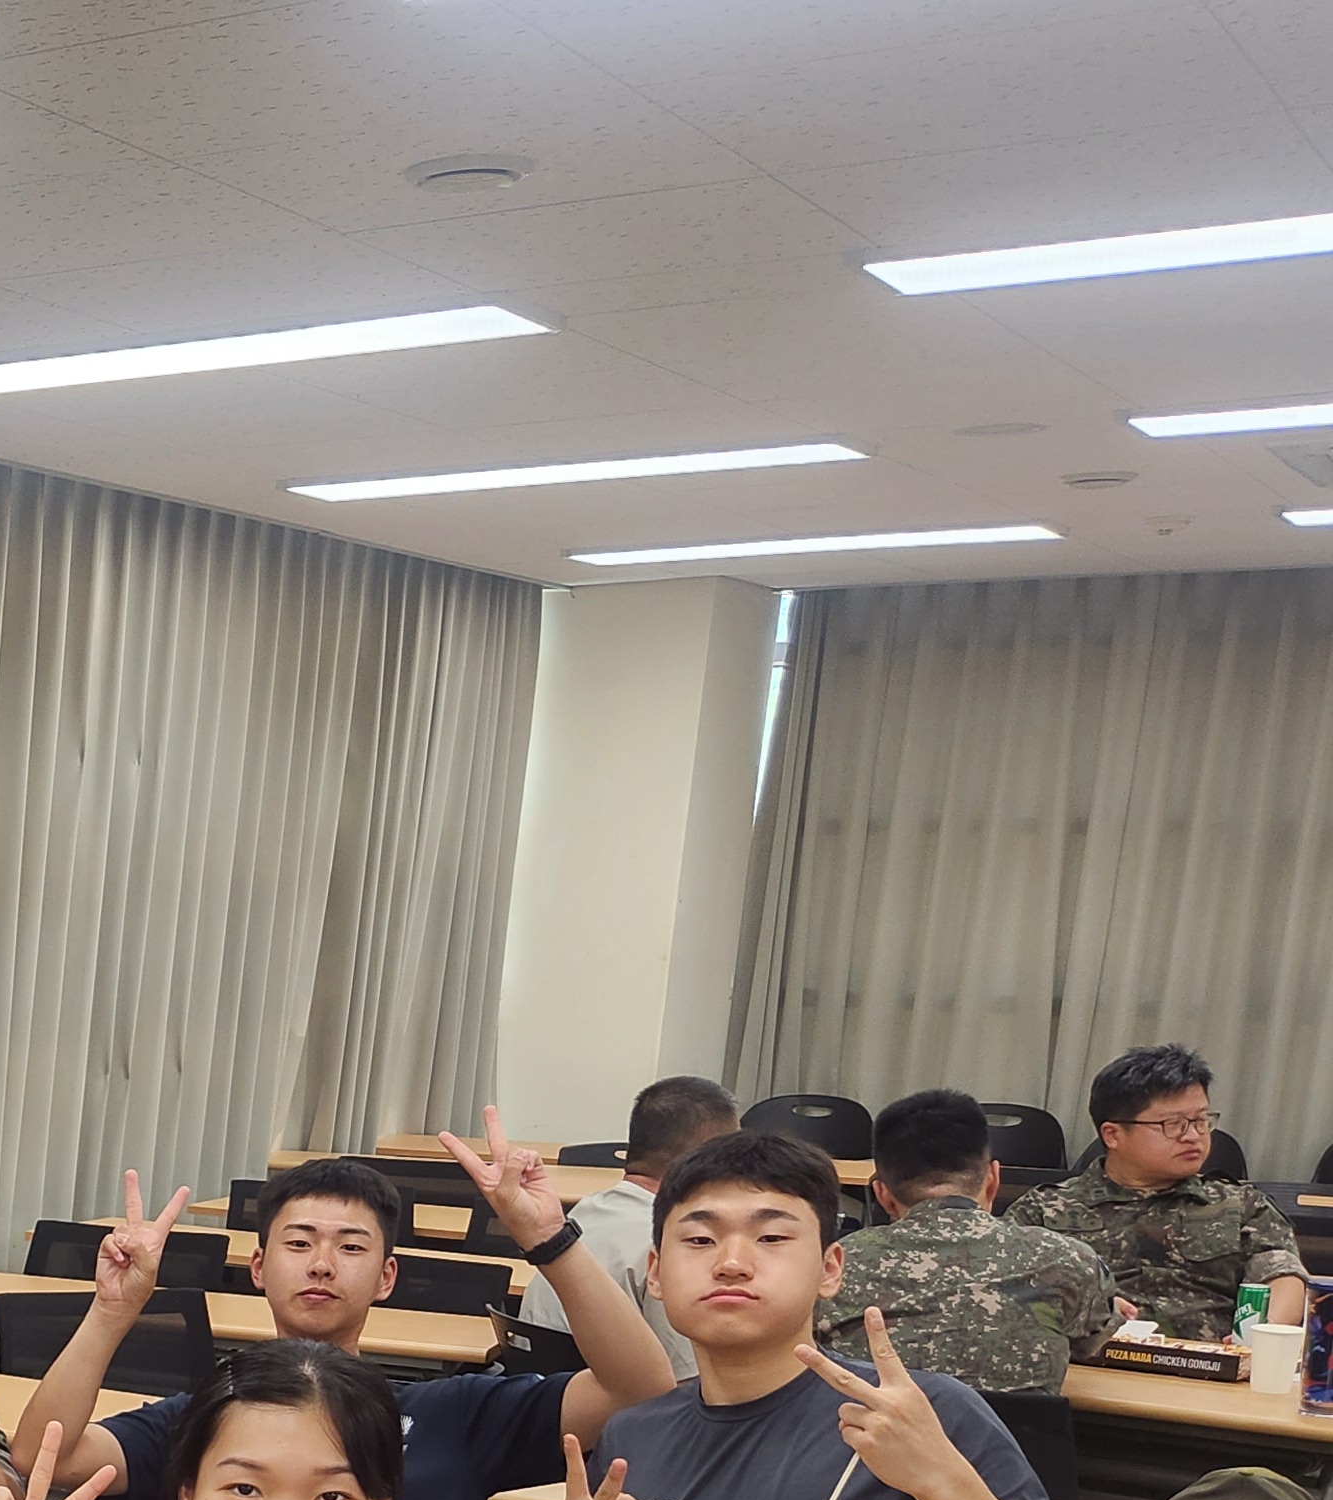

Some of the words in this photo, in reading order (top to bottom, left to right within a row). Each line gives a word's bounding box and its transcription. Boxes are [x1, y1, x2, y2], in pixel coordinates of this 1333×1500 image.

[1106, 1349, 1128, 1360] PIZZA
[1130, 1352, 1151, 1363] NARA
[1153, 1354, 1187, 1368] CHICKEN
[1189, 1359, 1221, 1371] GONGJU
